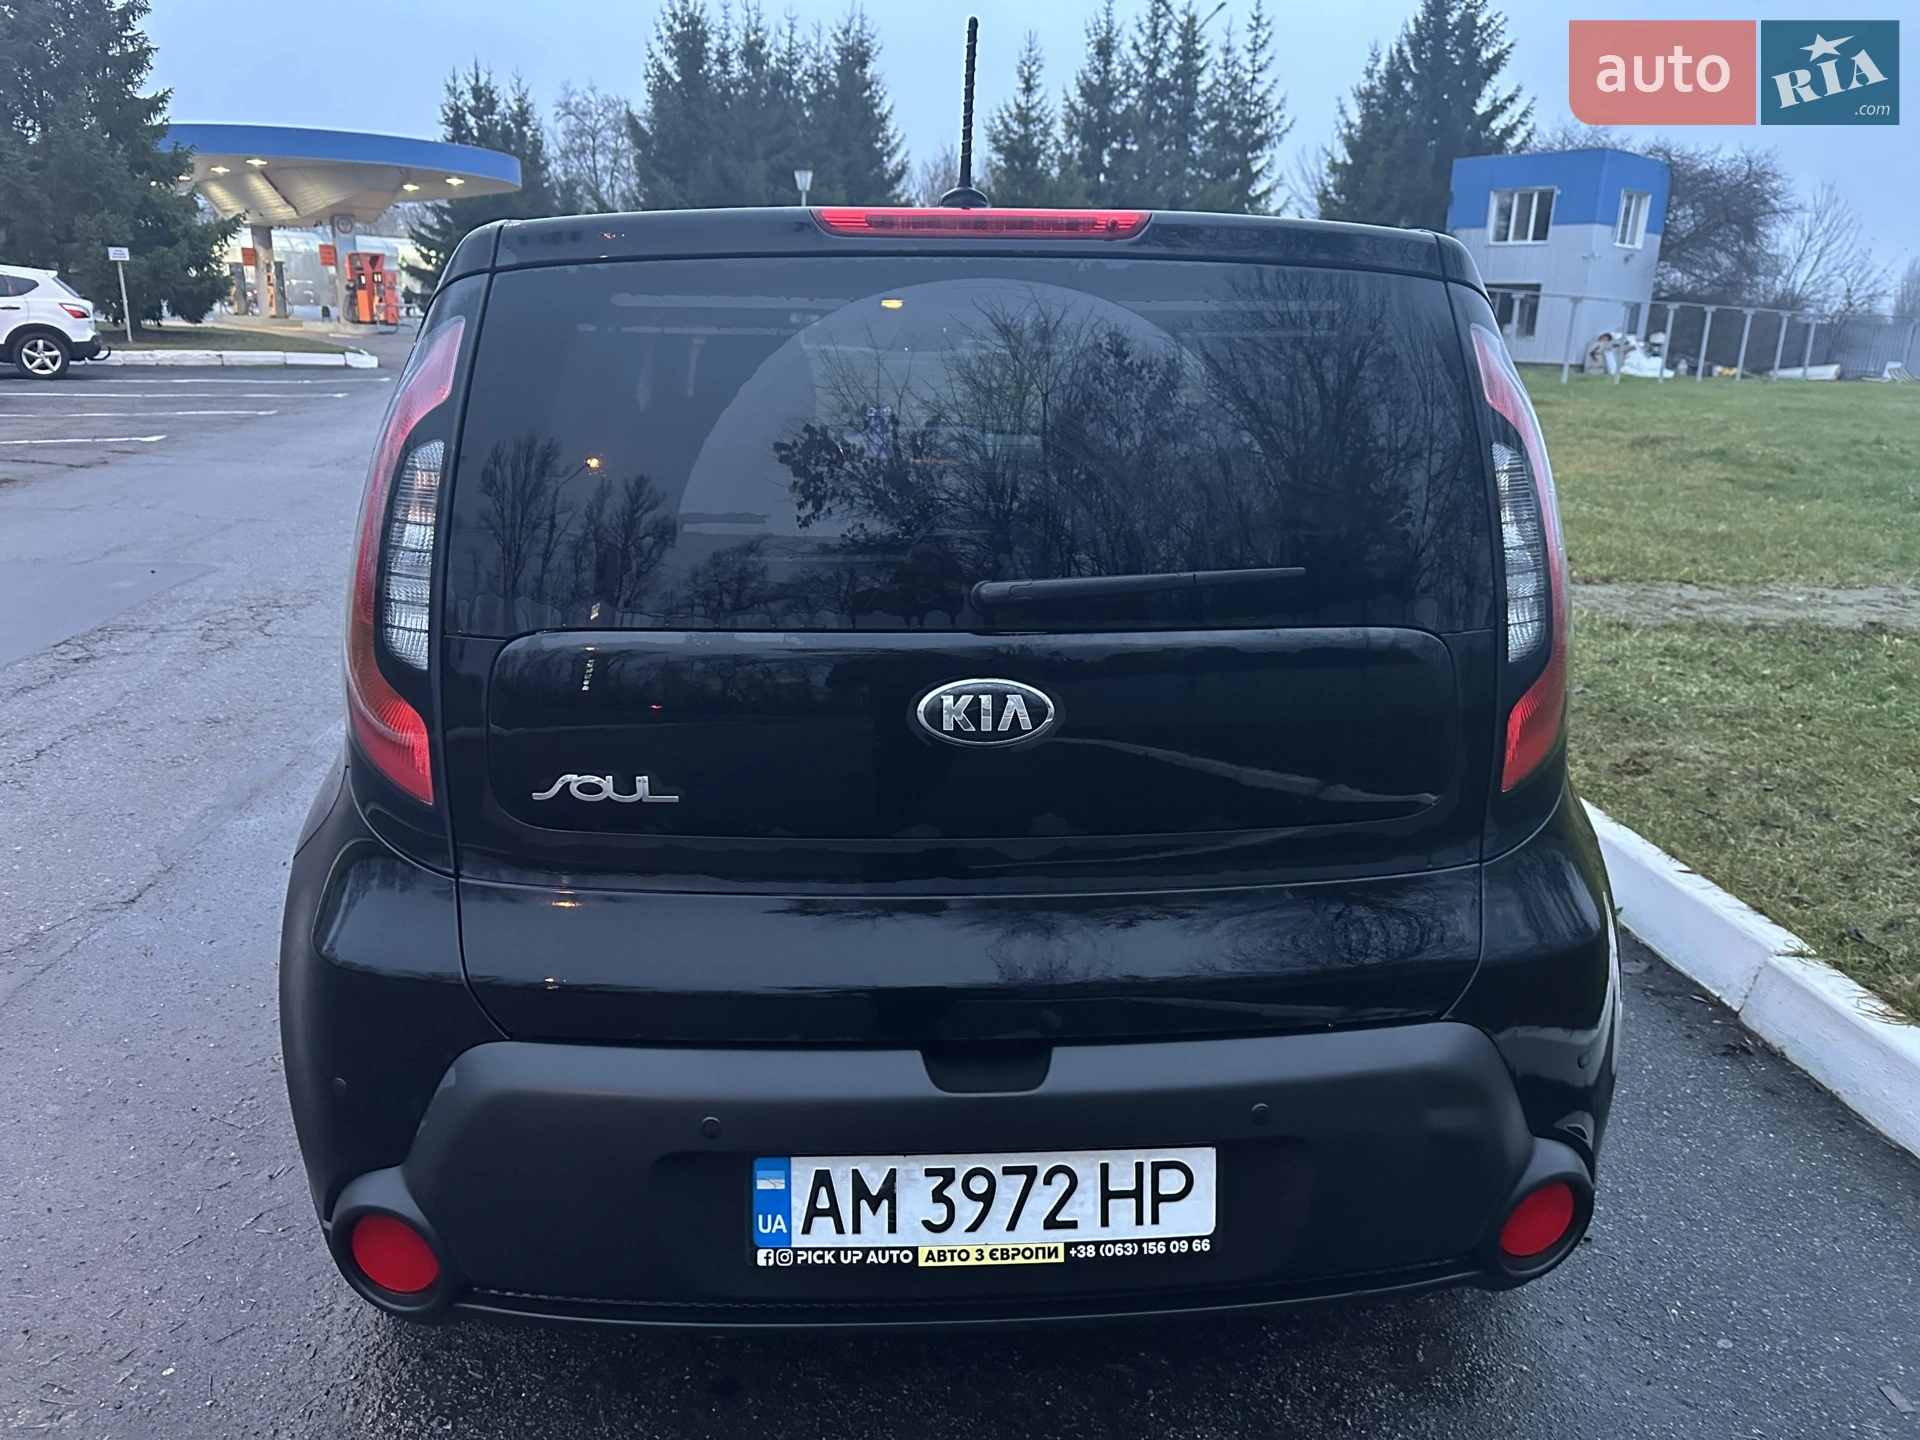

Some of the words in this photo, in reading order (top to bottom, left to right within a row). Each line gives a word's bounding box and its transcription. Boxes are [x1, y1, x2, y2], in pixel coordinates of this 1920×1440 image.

[942, 694, 1033, 731] KIA
[532, 774, 679, 803] SOUL
[801, 1167, 897, 1236] AM
[921, 1164, 1079, 1234] 3972
[1099, 1160, 1195, 1228] HP
[757, 1214, 787, 1235] UA
[797, 1250, 836, 1264] PICK
[840, 1250, 862, 1264] UP
[866, 1250, 913, 1264] AUTO
[924, 1249, 971, 1263] АВТО
[989, 1246, 1059, 1262] ЄВРОПИ
[1069, 1244, 1096, 1258] +38
[1099, 1242, 1139, 1257] (063)
[1142, 1241, 1166, 1255] 156
[1169, 1240, 1189, 1254] 09
[1192, 1239, 1211, 1252] 66
